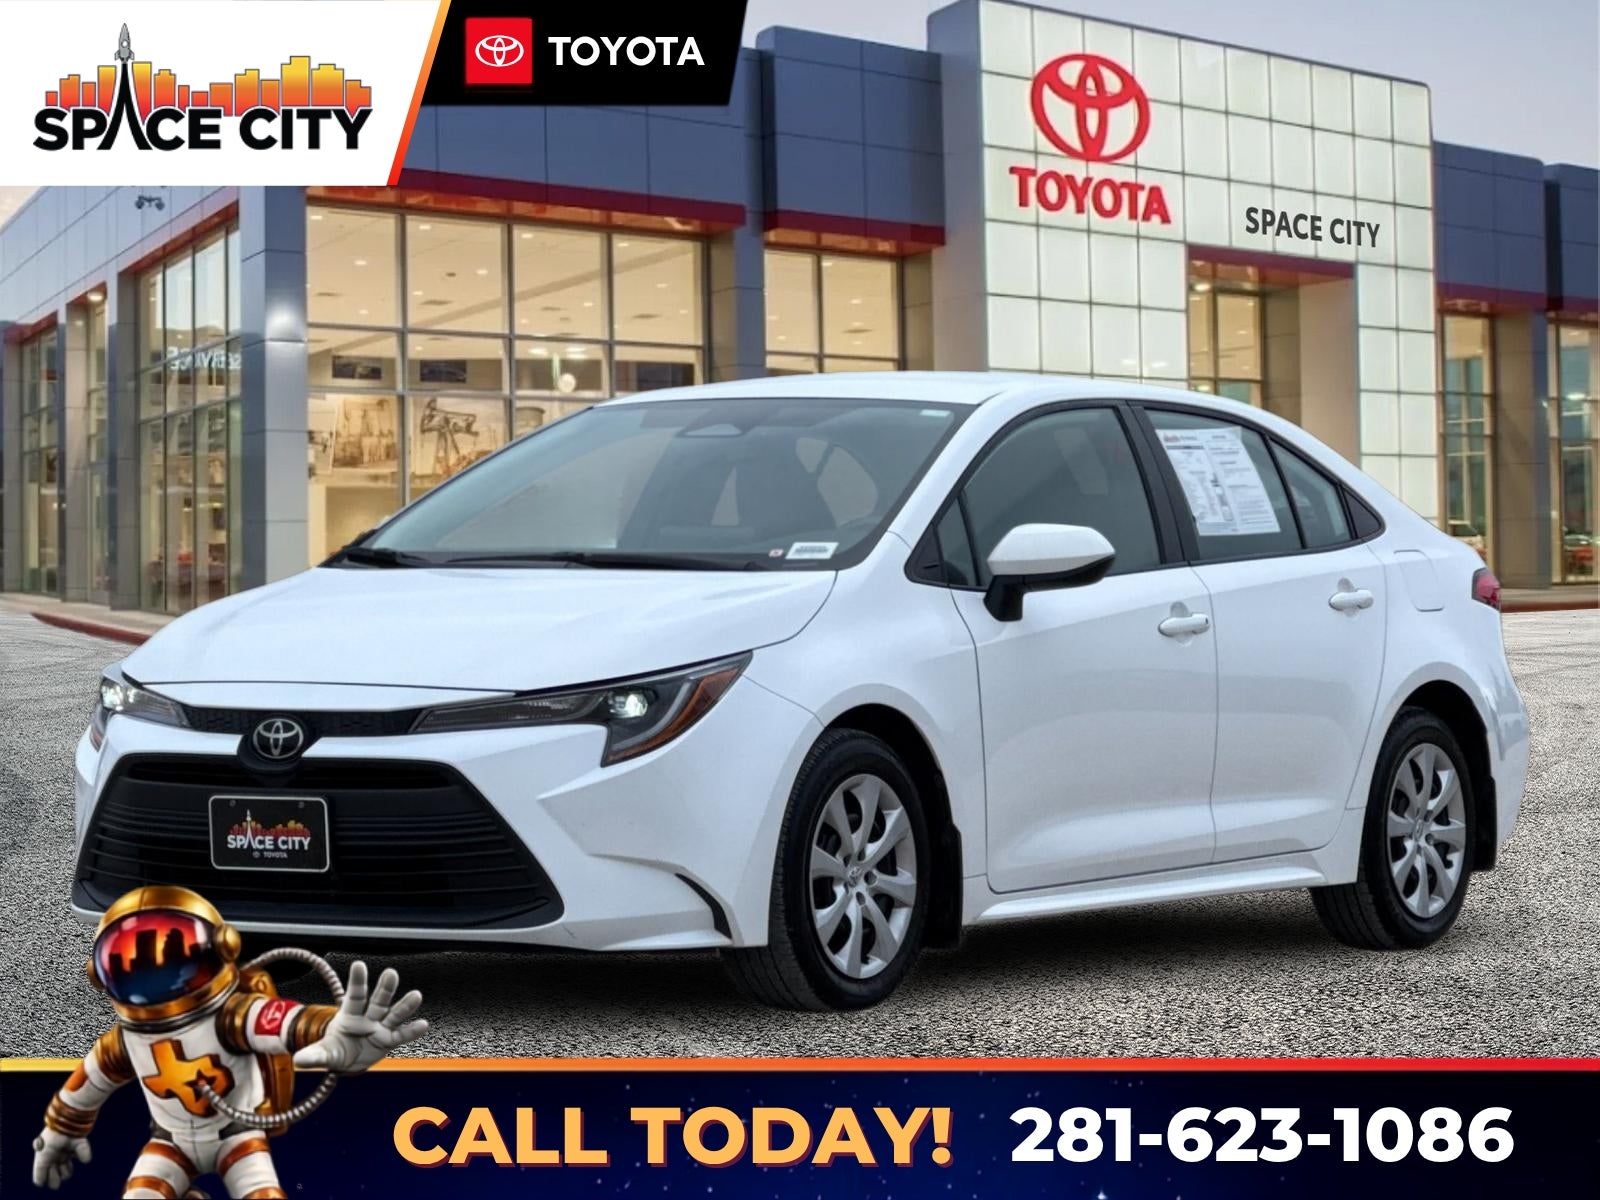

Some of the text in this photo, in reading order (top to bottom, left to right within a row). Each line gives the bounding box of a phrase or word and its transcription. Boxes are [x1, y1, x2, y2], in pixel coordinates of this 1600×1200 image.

[1009, 166, 1171, 224] TOYOTA
[1245, 206, 1380, 248] SPACE CITY
[263, 851, 288, 859] TOYOTA
[277, 836, 311, 851] CITY
